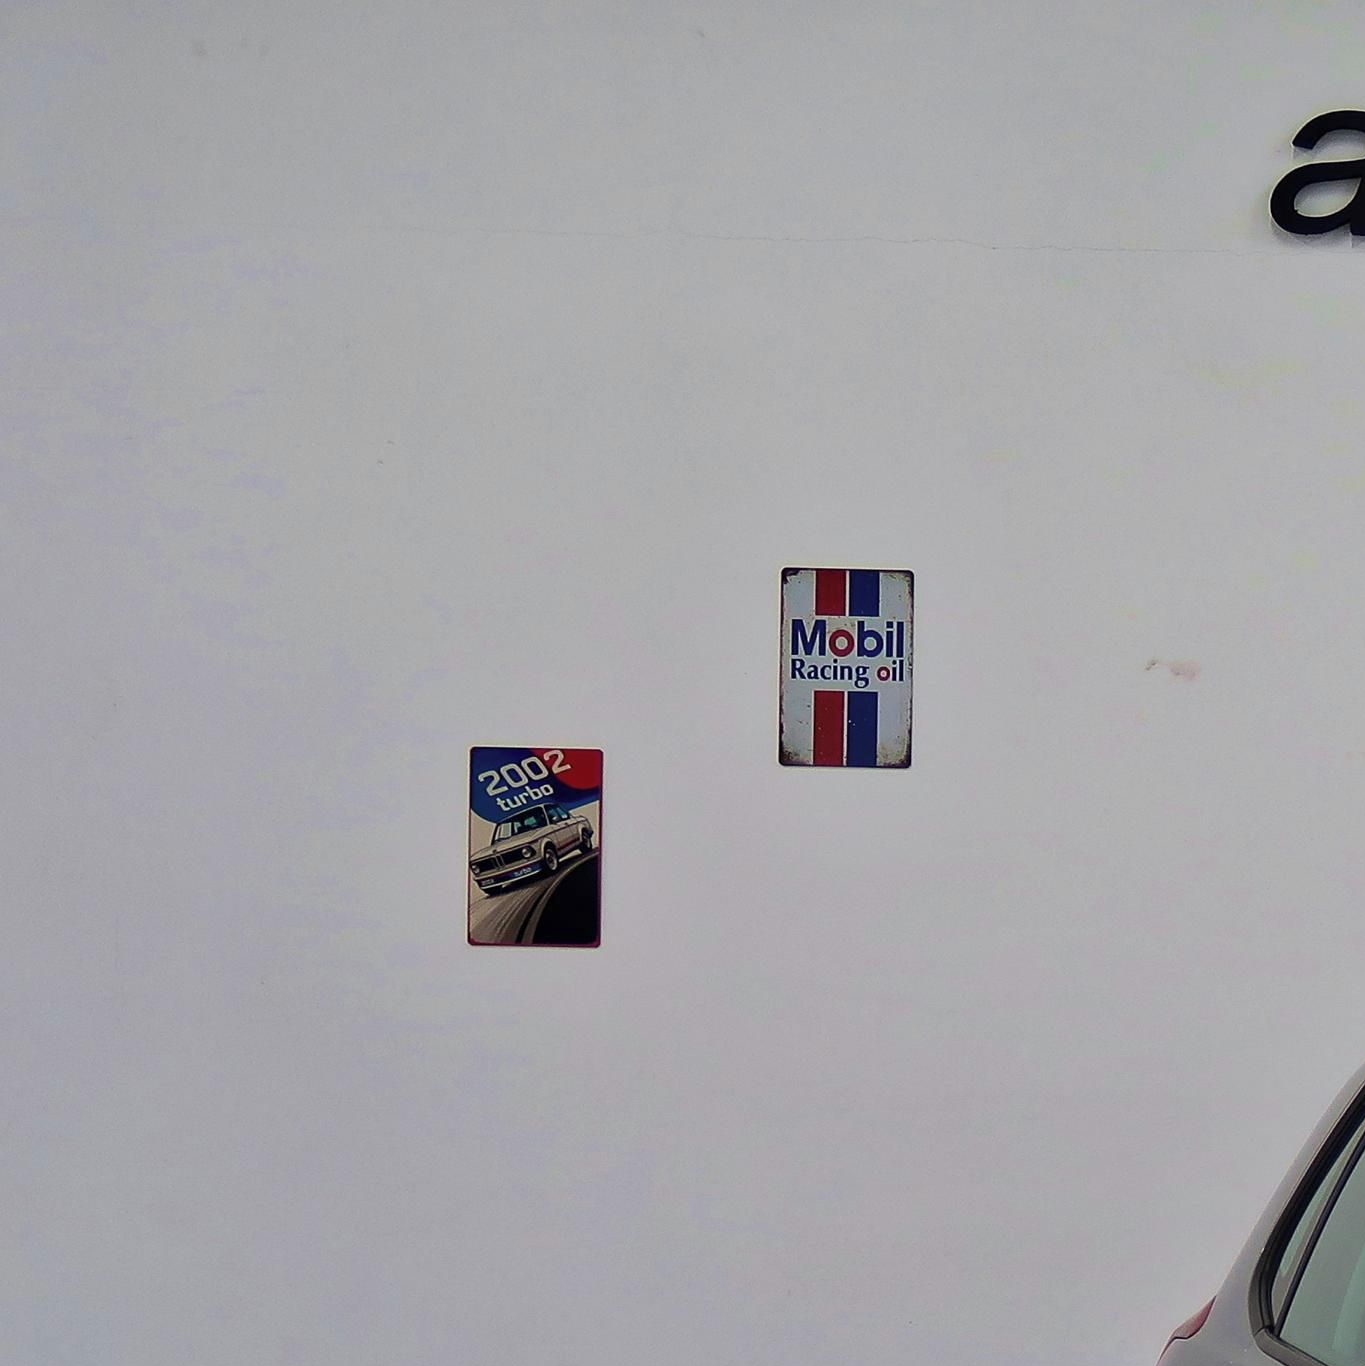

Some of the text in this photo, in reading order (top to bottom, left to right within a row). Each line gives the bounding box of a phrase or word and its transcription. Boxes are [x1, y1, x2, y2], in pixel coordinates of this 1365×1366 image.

[790, 618, 905, 659] Mobil
[790, 659, 905, 688] Racing oil
[478, 749, 572, 797] 2002
[496, 783, 554, 812] turbo
